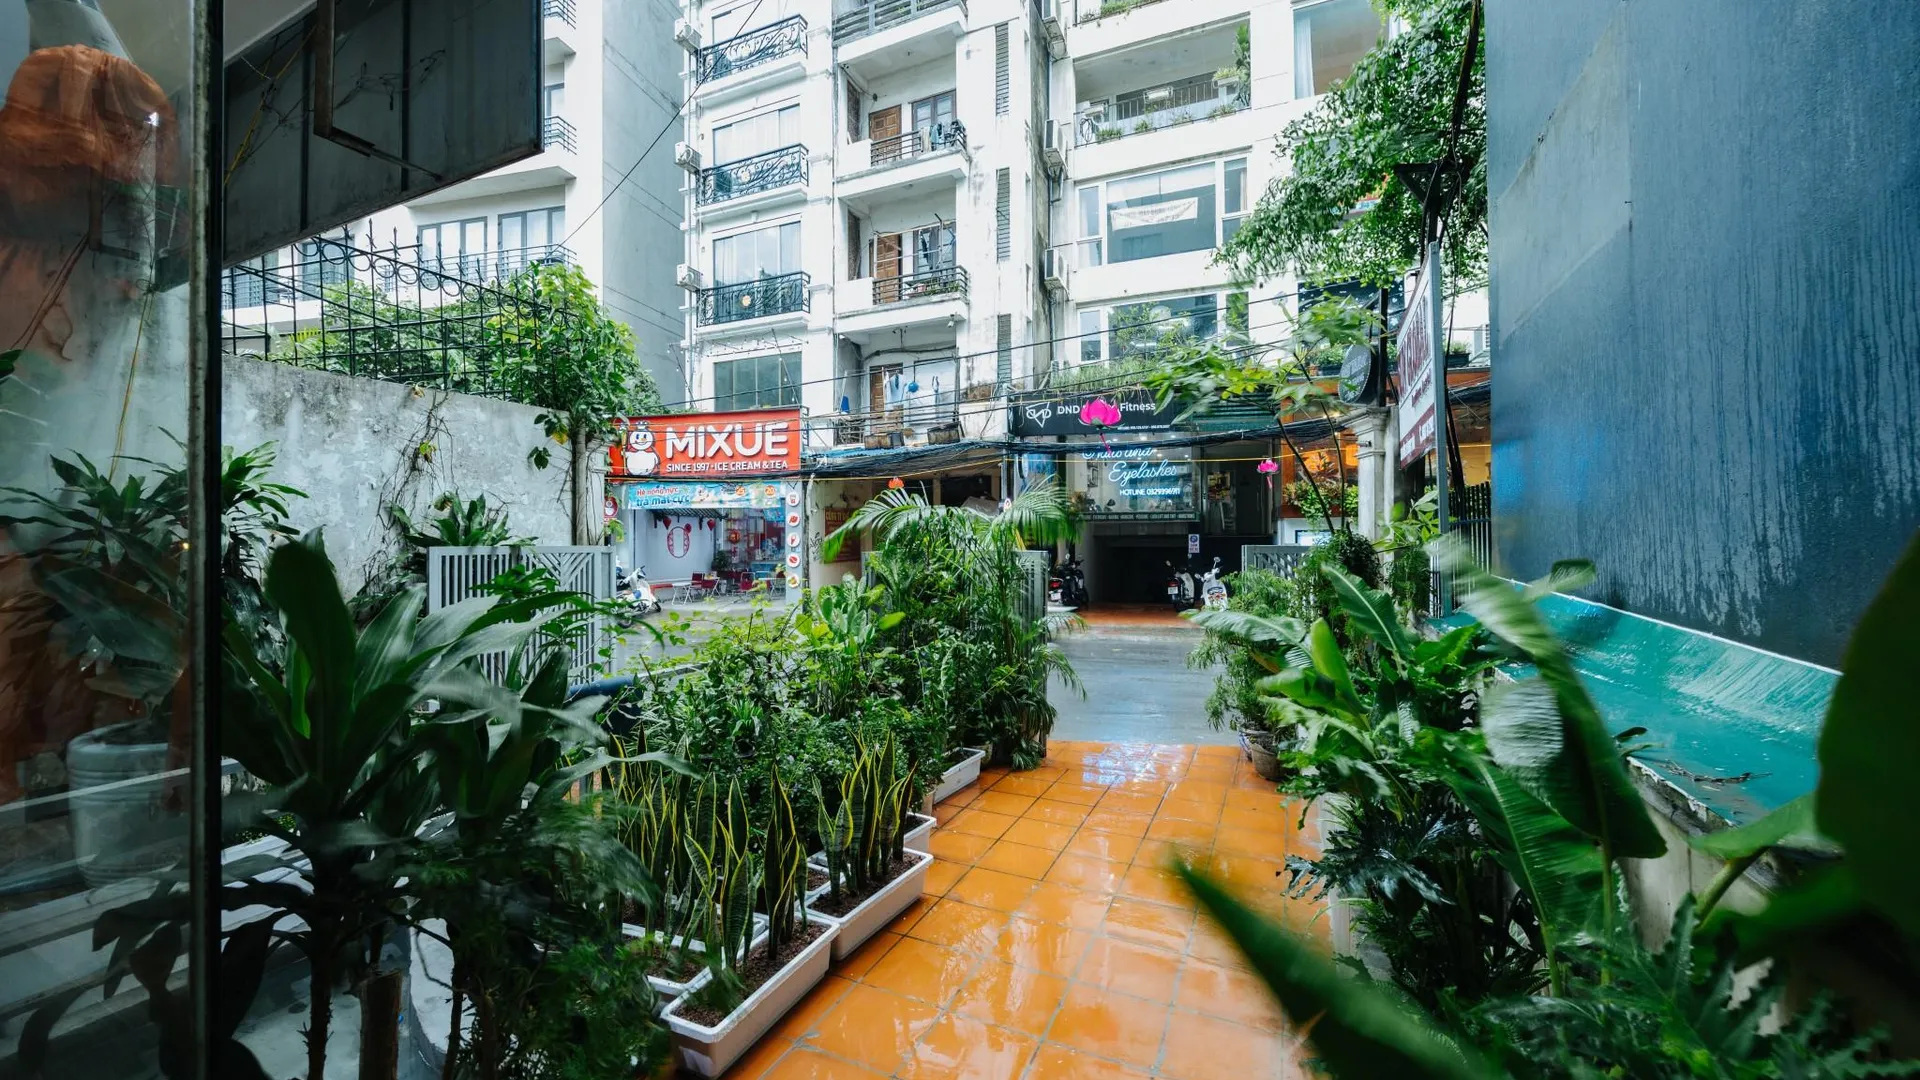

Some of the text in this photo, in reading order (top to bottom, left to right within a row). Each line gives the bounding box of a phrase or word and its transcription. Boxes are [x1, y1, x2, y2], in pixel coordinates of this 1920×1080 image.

[1057, 401, 1156, 415] DND Fitness
[665, 421, 789, 460] MIXUE
[666, 463, 691, 472] SINCE
[730, 461, 761, 470] CREAM
[762, 460, 769, 469] &
[769, 460, 788, 469] TEA
[1108, 459, 1177, 487] Eyelashes
[1119, 488, 1146, 496] HOTLINE
